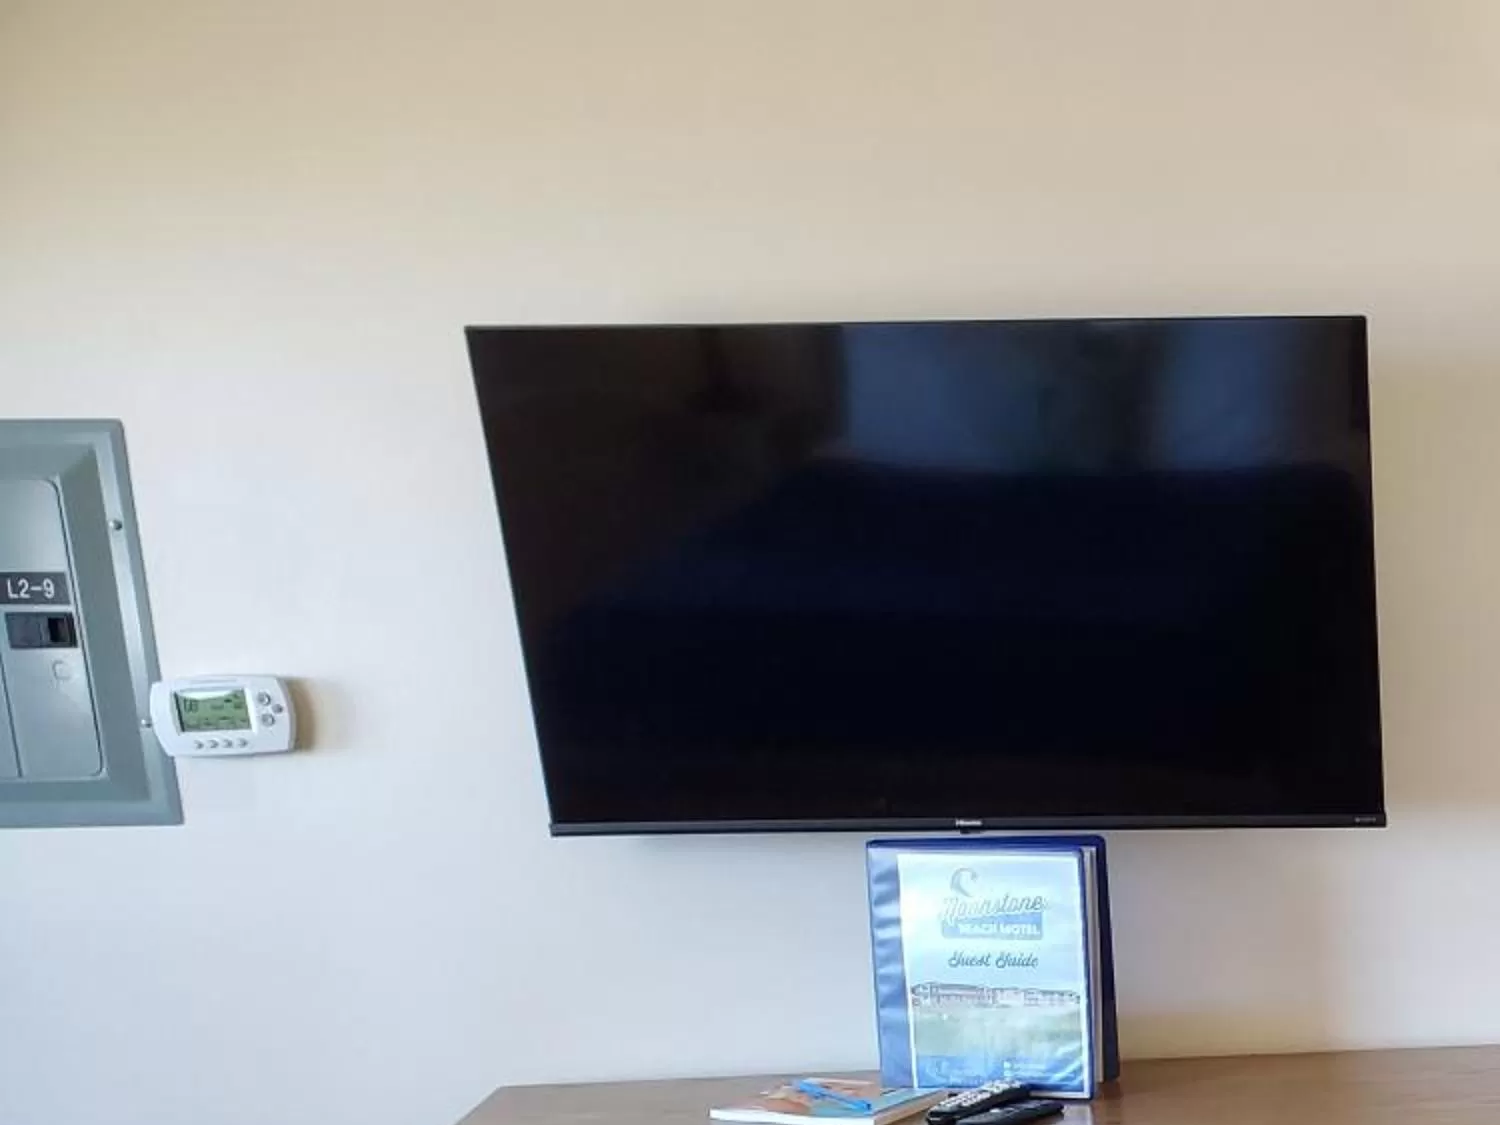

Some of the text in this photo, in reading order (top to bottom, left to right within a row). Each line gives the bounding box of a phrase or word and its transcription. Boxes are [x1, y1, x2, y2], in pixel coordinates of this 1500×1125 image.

[7, 578, 55, 599] L2-9
[948, 951, 1039, 968] Guest Guide
